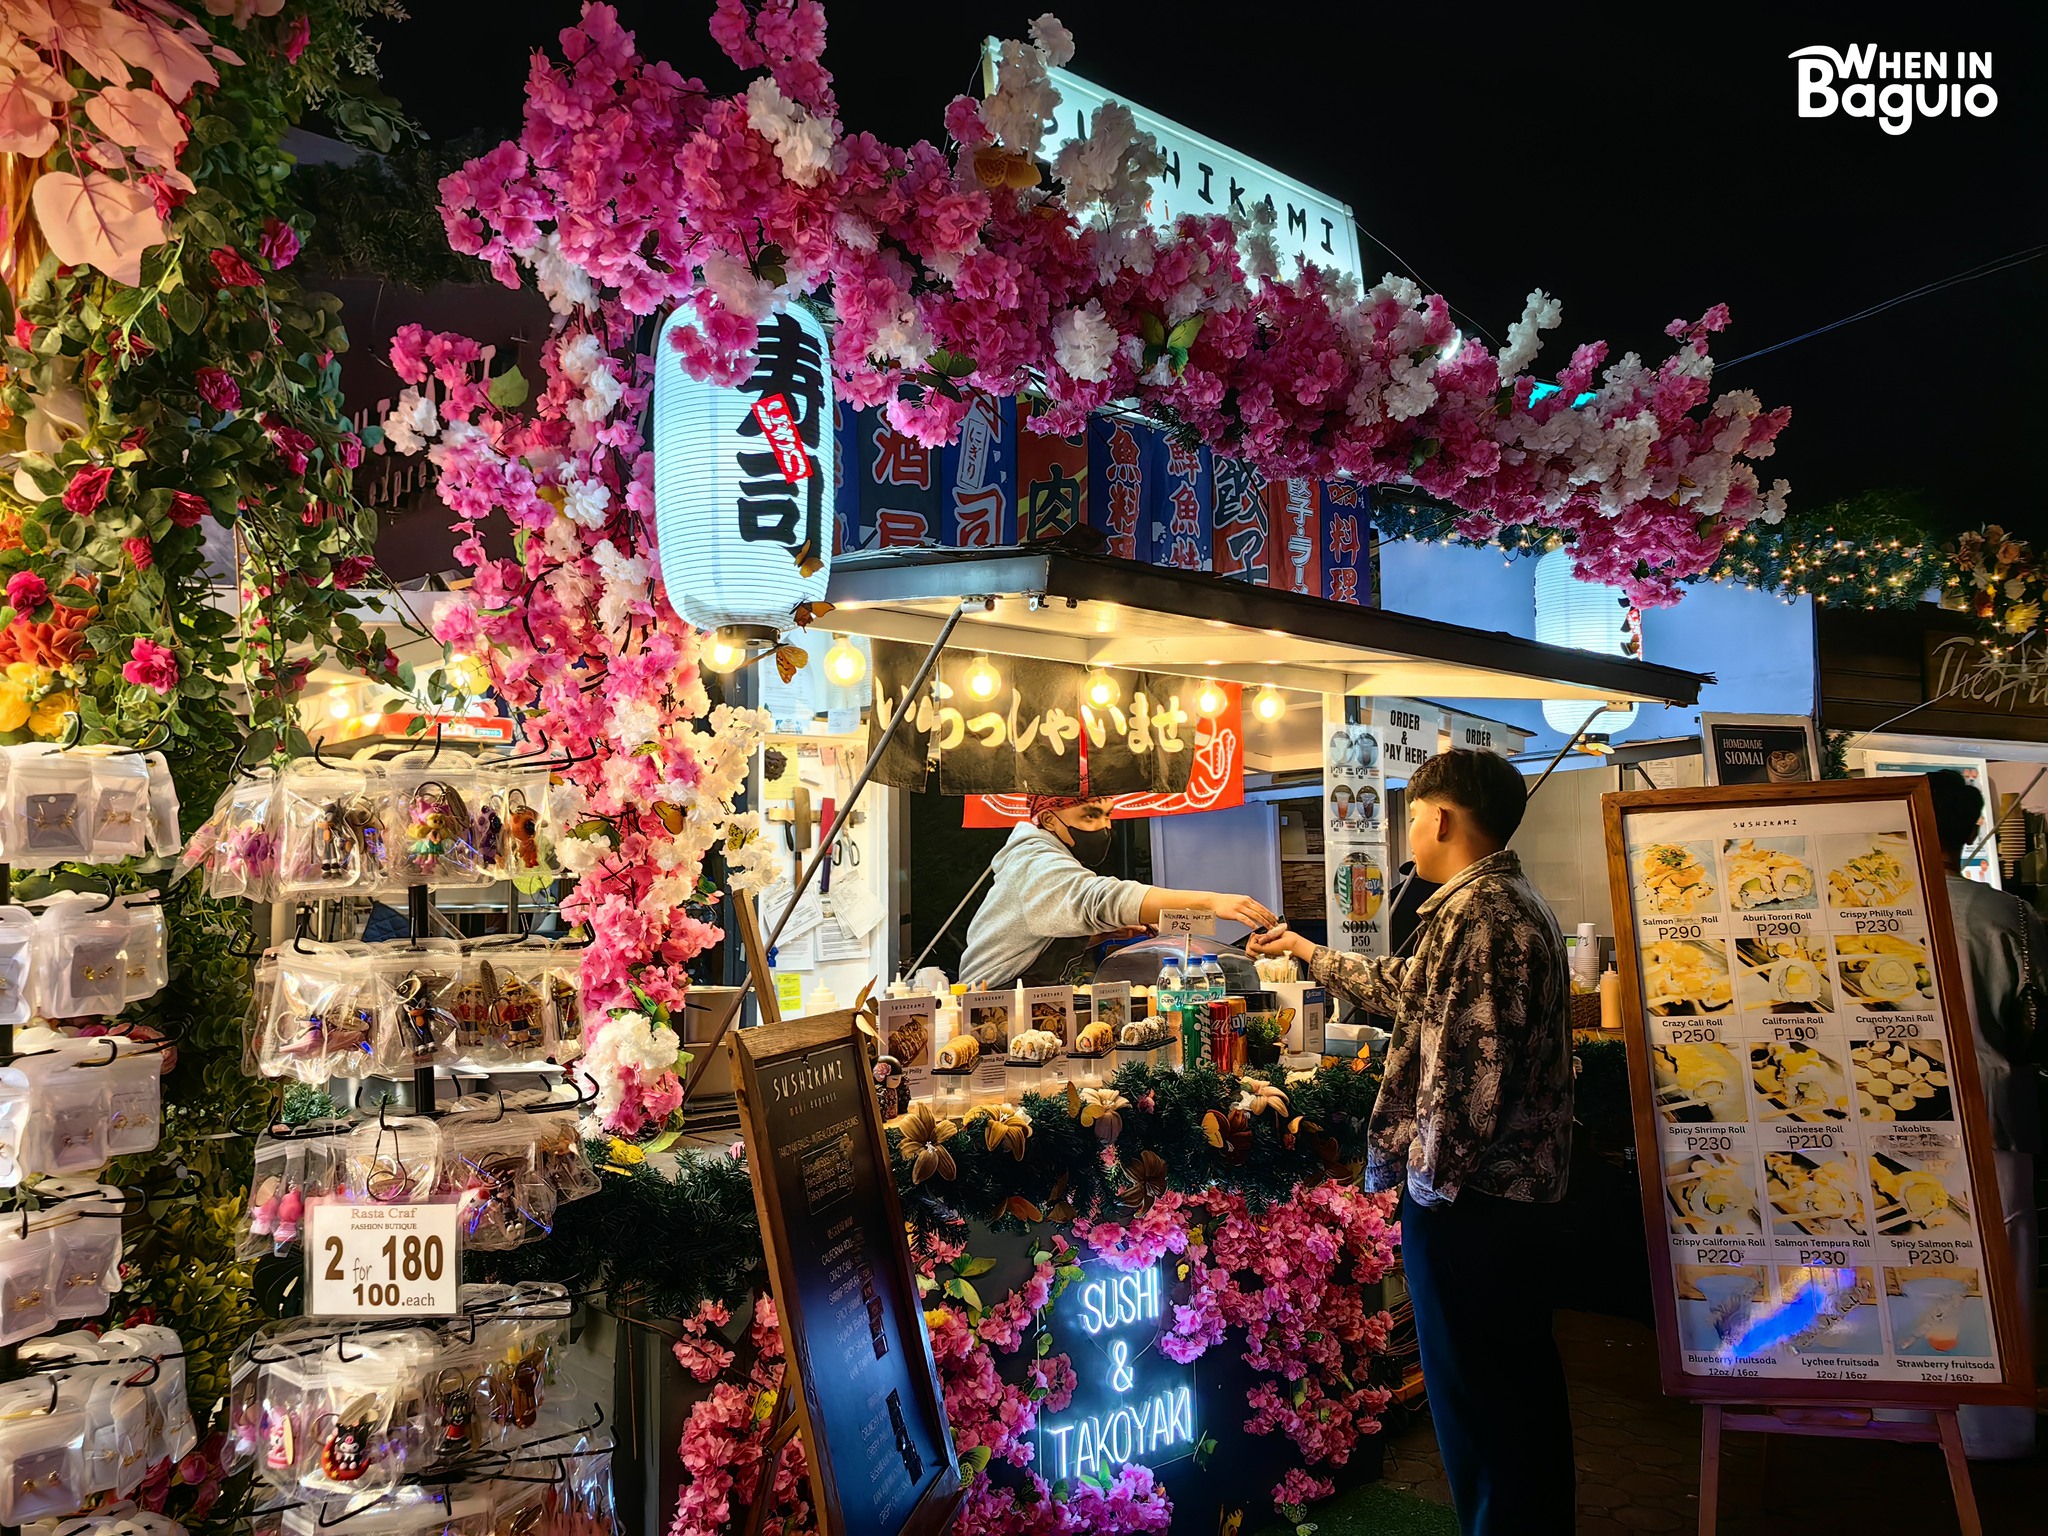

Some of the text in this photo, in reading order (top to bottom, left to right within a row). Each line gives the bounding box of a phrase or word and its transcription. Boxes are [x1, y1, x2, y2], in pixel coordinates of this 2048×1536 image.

[875, 676, 1189, 757] いらっしゃいませ
[1390, 709, 1420, 731] ORDER
[1400, 730, 1408, 745] &
[1465, 727, 1492, 748] ORDER
[1722, 738, 1764, 750] HOMEMADE
[1384, 742, 1428, 765] PAY HERE
[1724, 750, 1764, 766] SIOMAI
[1733, 819, 1798, 829] SUSHIKAMI
[1642, 917, 1674, 926] Salmon
[1701, 916, 1718, 924] Roll
[1742, 914, 1766, 922] Aburi
[1794, 912, 1812, 920] Roll
[1840, 908, 1913, 920] Crispy Philly Roll
[1342, 920, 1378, 934] SODA
[1658, 925, 1701, 940] P290
[1756, 922, 1801, 937] P290
[1855, 918, 1900, 934] P230
[1351, 935, 1371, 947] P50
[1662, 1018, 1723, 1028] Crazy Cali Roll
[1762, 1016, 1824, 1026] California Roll
[1855, 1014, 1934, 1024] Crunchy Kani Roll
[1672, 1028, 1716, 1043] P250
[1874, 1024, 1919, 1040] P220
[773, 1060, 843, 1102] SUSHIKAMI
[1668, 1125, 1746, 1135] Spicy Shrimp Roll
[1775, 1124, 1844, 1134] Calicheese Roll
[1892, 1124, 1931, 1133] Takobits
[1686, 1136, 1731, 1151] P230
[1790, 1134, 1834, 1150] P210
[351, 1207, 418, 1219] Rasta Craf
[1672, 1238, 1766, 1248] Crispy California Roll
[1774, 1238, 1870, 1248] Salmon Tempura Roll
[1890, 1239, 1973, 1250] Spicy Salmon Roll
[324, 1235, 444, 1284] 2 for 180
[1697, 1248, 1741, 1264] P220
[1800, 1250, 1846, 1265] P230
[1908, 1249, 1954, 1265] P230
[1079, 1266, 1159, 1334] SUSHI
[1110, 1340, 1134, 1392] &
[1688, 1354, 1777, 1366] Blueberry fruitsoda
[1801, 1357, 1880, 1368] Lychee fruitsoda
[1896, 1360, 1995, 1371] Strawberry fruitsoda
[1049, 1386, 1193, 1478] TAKOYAKI
